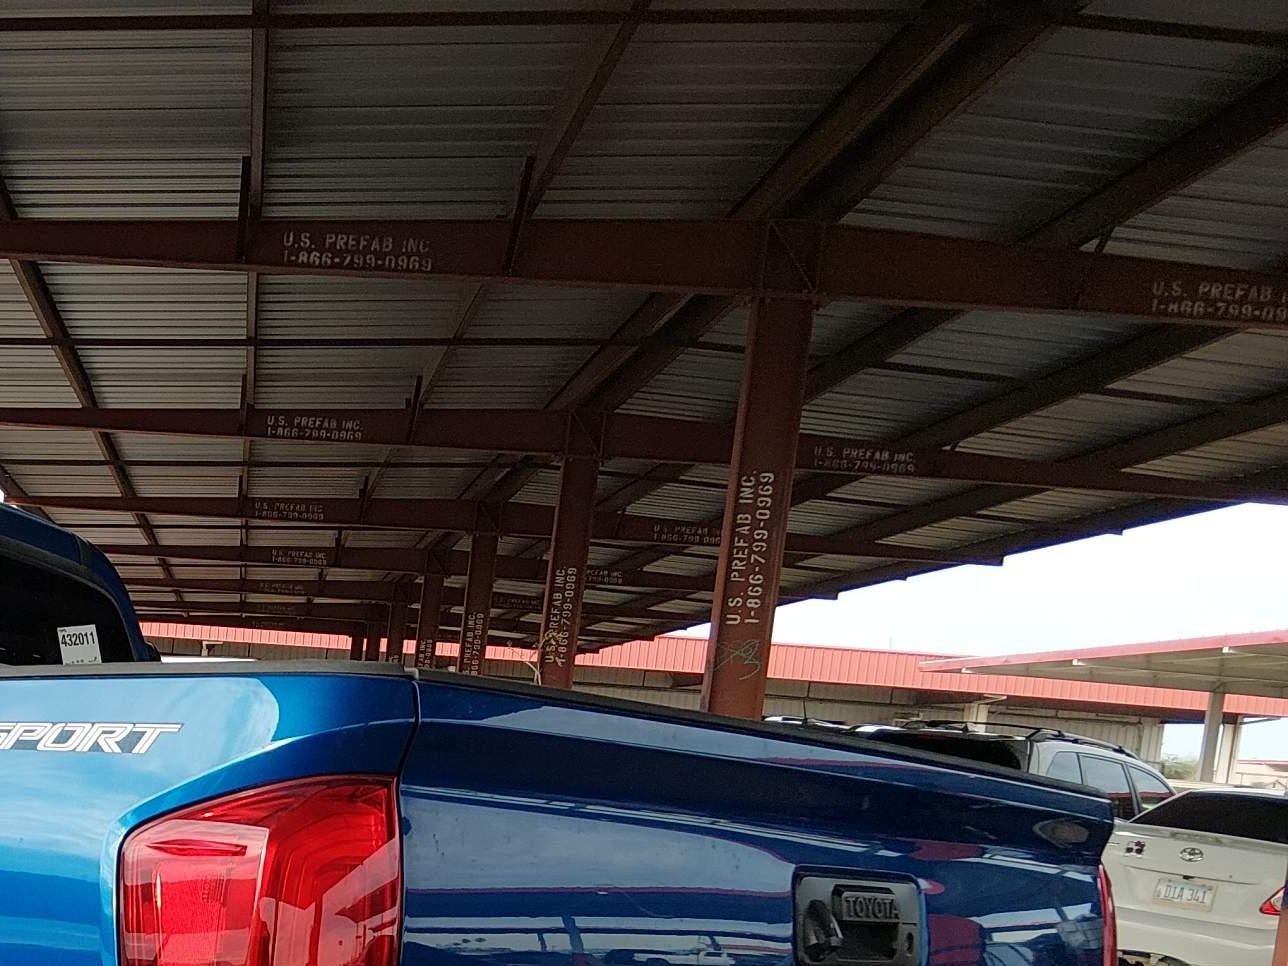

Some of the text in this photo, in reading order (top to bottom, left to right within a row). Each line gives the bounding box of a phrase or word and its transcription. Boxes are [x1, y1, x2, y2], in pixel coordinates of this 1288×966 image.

[283, 231, 316, 249] U.S.
[325, 233, 393, 251] PREFAB
[1152, 280, 1188, 297] U.S.
[1198, 281, 1273, 302] PREFAB
[267, 415, 289, 427] U.S.
[294, 416, 337, 429] PREFAB
[725, 470, 758, 625] U.S. PREFAB INC.
[743, 472, 775, 624] 1-866-799-0969
[60, 631, 95, 647] 432011
[845, 896, 900, 920] TOYOTA
